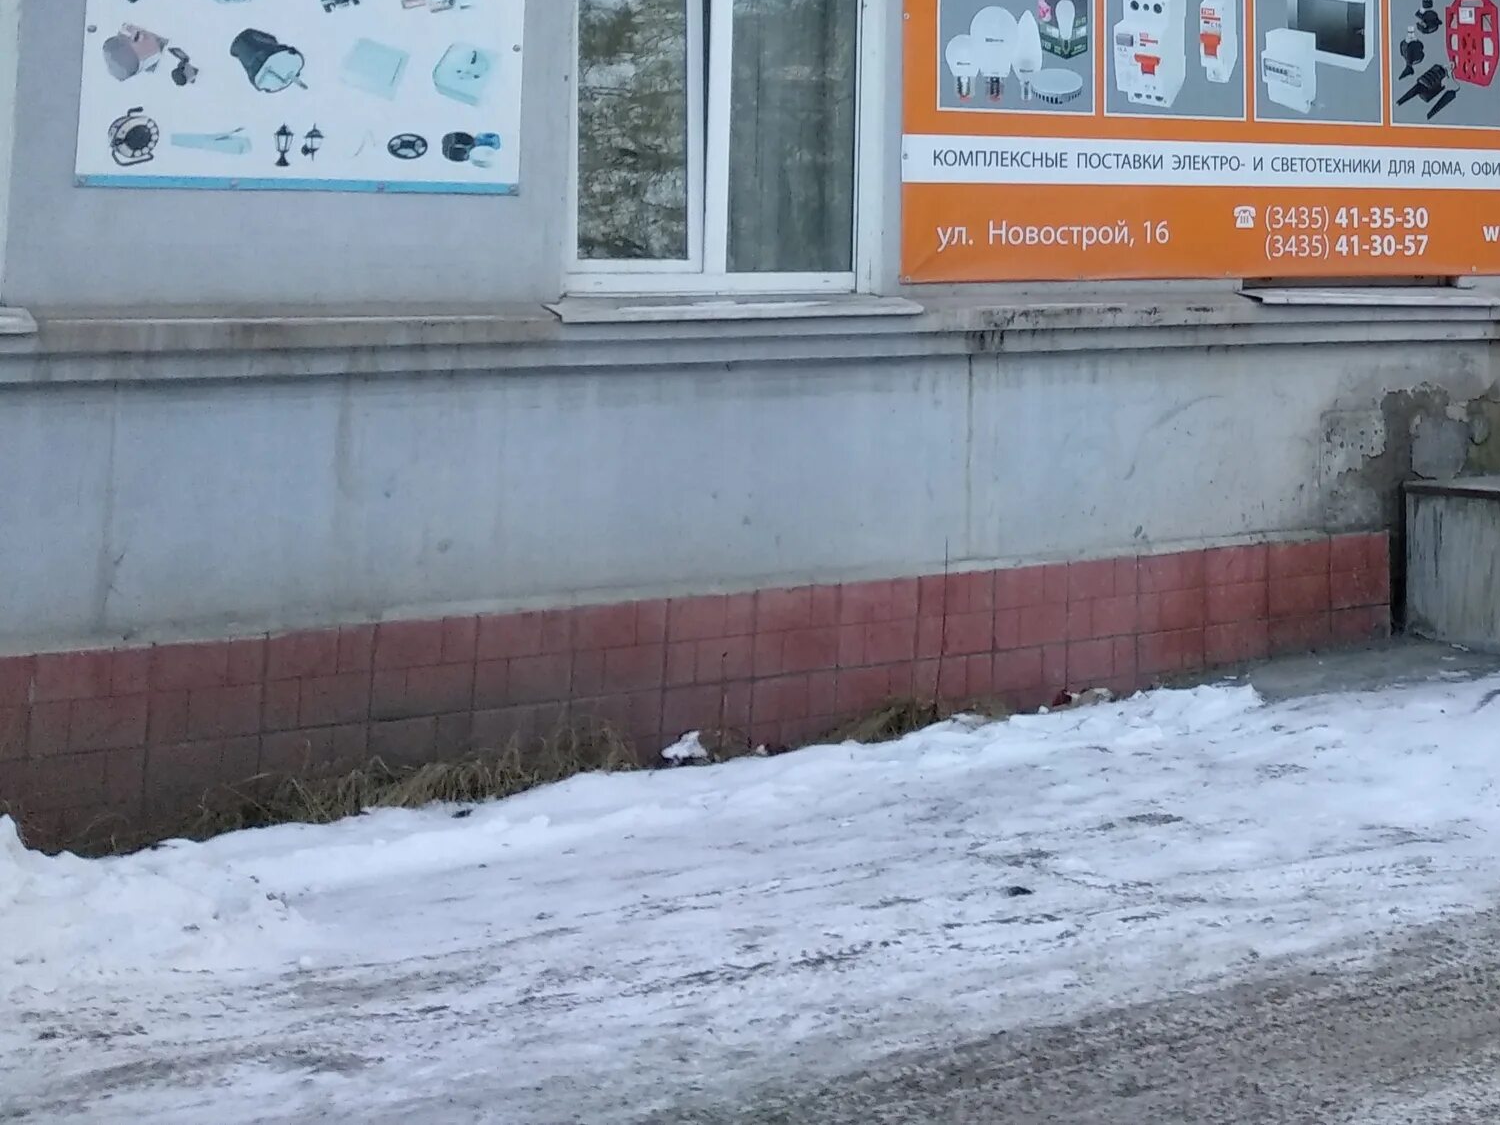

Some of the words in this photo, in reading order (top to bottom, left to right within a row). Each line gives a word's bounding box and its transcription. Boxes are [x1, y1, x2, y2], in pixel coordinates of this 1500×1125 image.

[932, 148, 1069, 170] КОМПЛЕКСНЫЕ
[1076, 152, 1164, 171] ПОСТАВКИ
[1171, 154, 1246, 172] ЭЛЕКТРО-
[1253, 156, 1264, 173] И
[1270, 156, 1382, 175] СВЕТОТЕХНИКИ
[1387, 159, 1416, 177] ДЛЯ
[1421, 159, 1466, 178] ДОМА,
[1264, 204, 1330, 232] (3435)
[1334, 206, 1430, 229] 41-35-30
[936, 224, 974, 252] ул.
[988, 220, 1135, 251] Новострой,
[1143, 220, 1170, 244] 16
[1264, 232, 1330, 261] (3435)
[1334, 233, 1430, 257] 41-30-57
